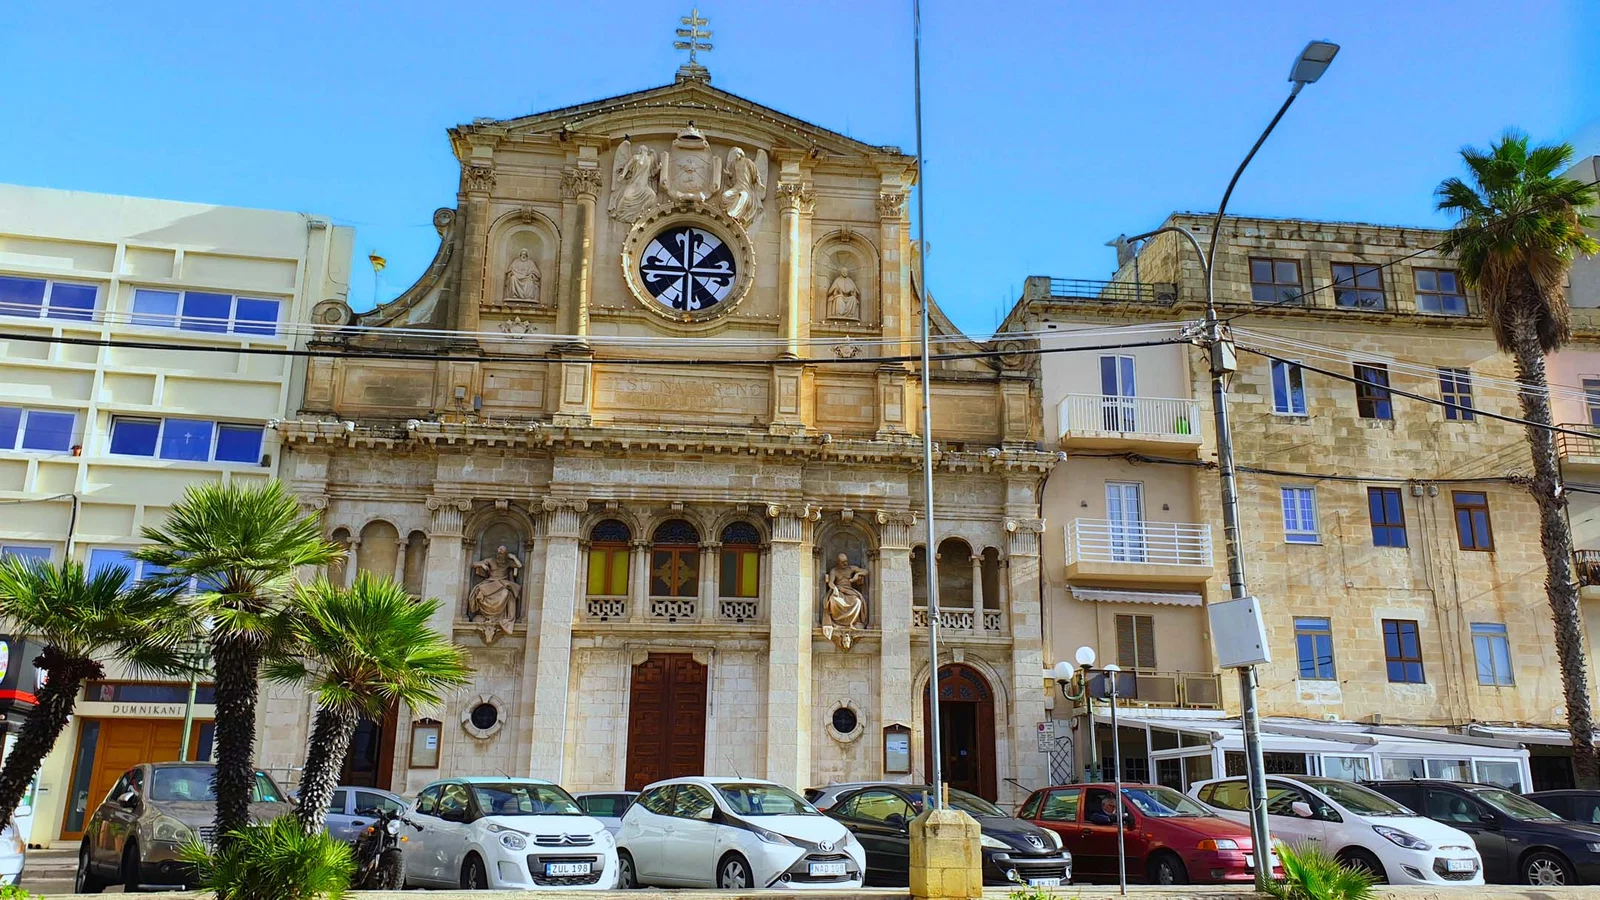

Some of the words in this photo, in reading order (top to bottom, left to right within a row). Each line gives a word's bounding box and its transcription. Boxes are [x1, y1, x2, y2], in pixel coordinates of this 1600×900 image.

[112, 705, 181, 715] DUMNIKANI
[552, 864, 569, 873] ZUL
[572, 864, 588, 873] 198
[814, 865, 829, 873] NAD
